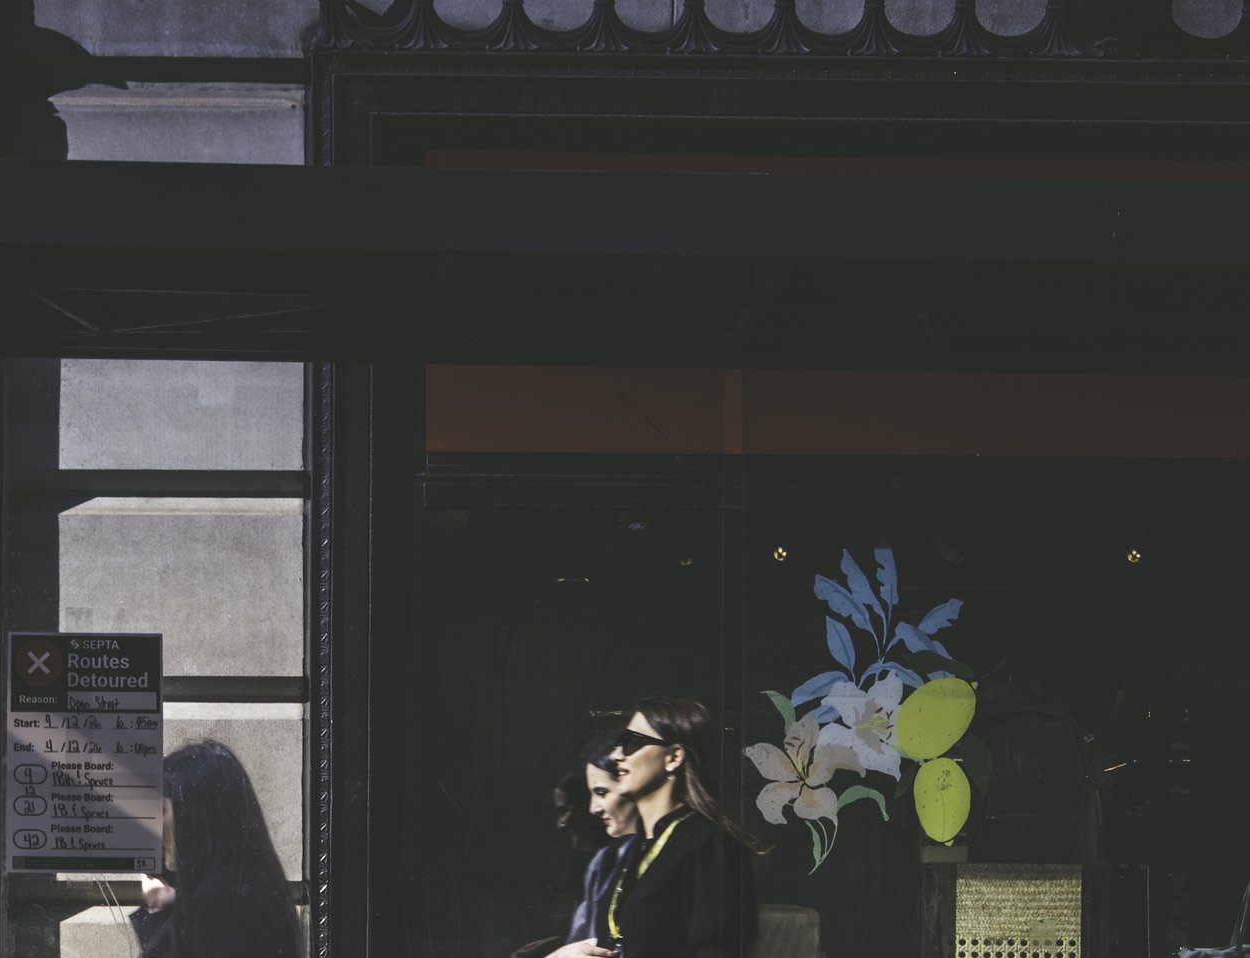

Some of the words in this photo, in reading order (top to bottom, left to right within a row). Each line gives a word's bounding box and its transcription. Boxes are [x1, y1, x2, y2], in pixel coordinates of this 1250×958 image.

[82, 639, 120, 650] SEPTA
[67, 653, 130, 669] Routes
[67, 672, 148, 689] Detoured
[19, 694, 58, 704] Reason:
[13, 718, 40, 728] Start:
[13, 742, 35, 752] End:
[51, 761, 83, 770] Please
[84, 761, 114, 770] Board:
[51, 793, 82, 802] Please
[84, 793, 113, 802] Board:
[53, 804, 67, 817] 18
[51, 824, 81, 833] Please
[83, 824, 113, 833] Board:
[23, 834, 40, 848] 42
[55, 837, 67, 849] 18
